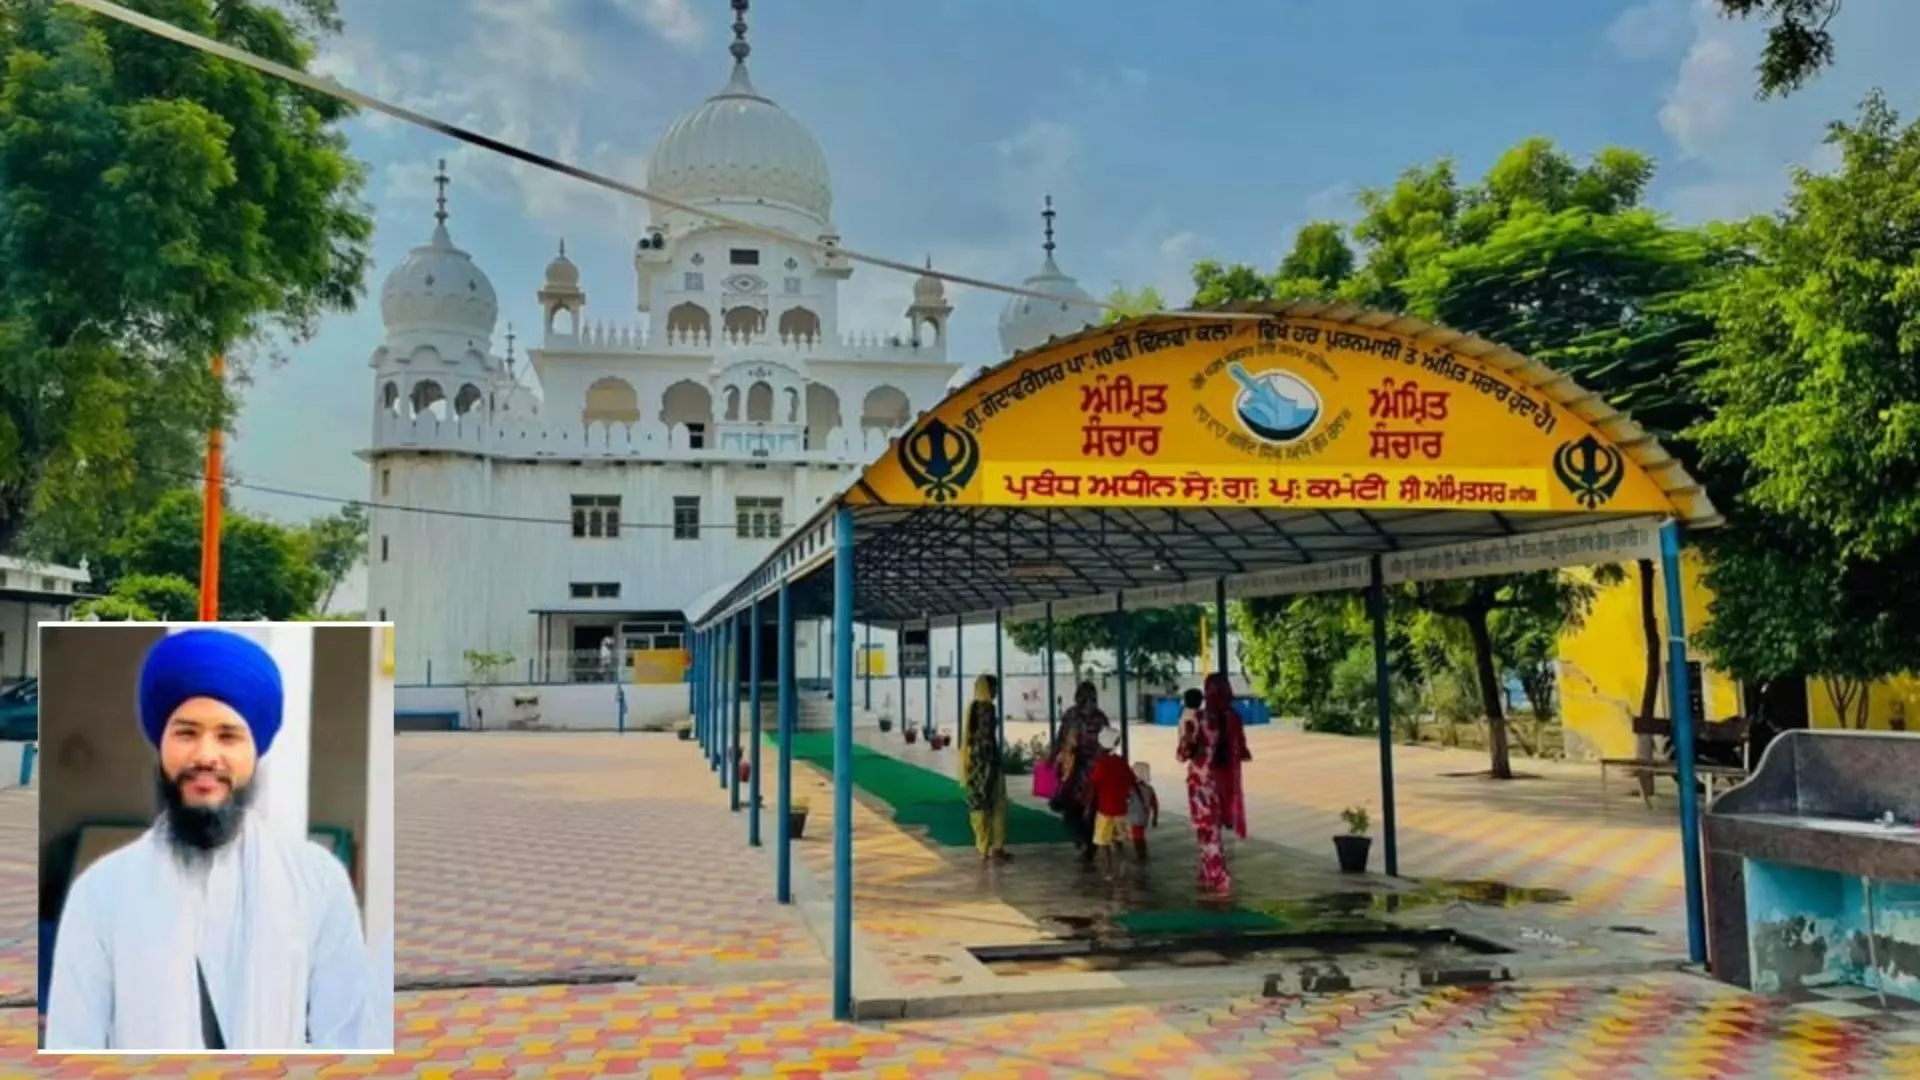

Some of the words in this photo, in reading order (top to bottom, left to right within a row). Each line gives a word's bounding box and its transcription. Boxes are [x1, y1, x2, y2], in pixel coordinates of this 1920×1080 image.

[1080, 374, 1168, 420] ਅੰਮ੍ਰਿਤ
[1367, 377, 1451, 426] ਅੰਮ੍ਰਿਤ
[1081, 415, 1162, 457] ਸੰਚਾਰ
[1368, 421, 1444, 459] ਸੰਚਾਰ
[1087, 469, 1176, 499] ਅਧੀਨ
[1306, 473, 1389, 501] ਕਮੇਟੀ
